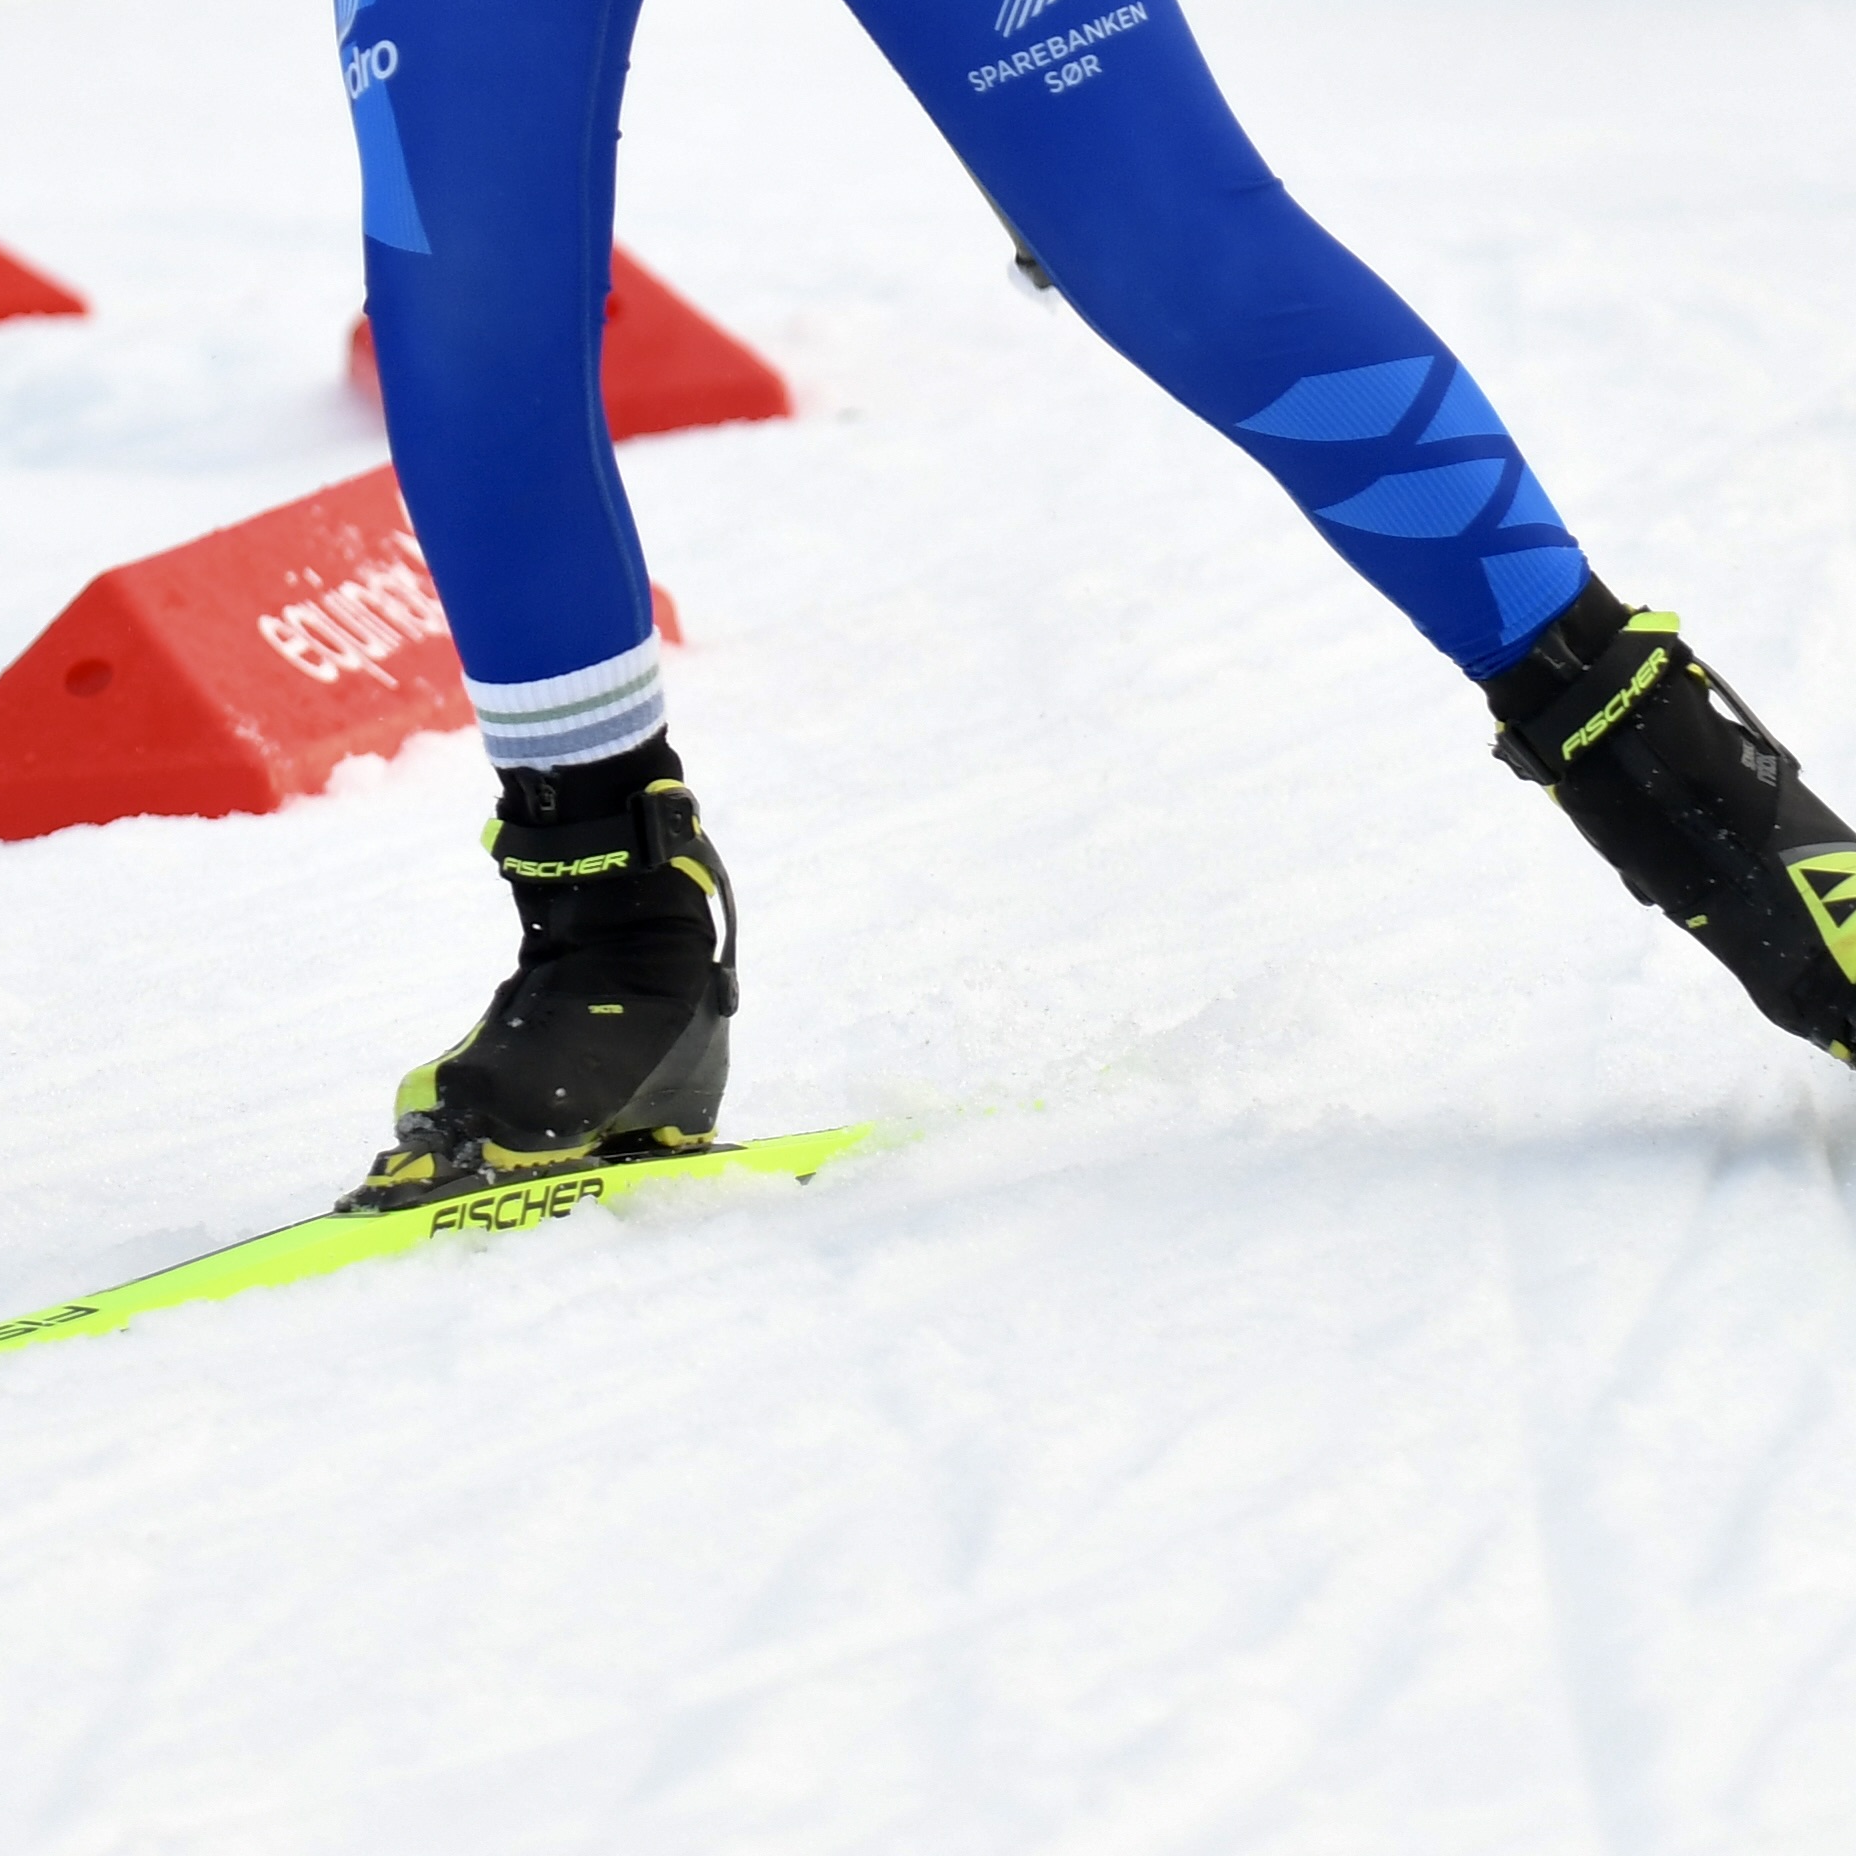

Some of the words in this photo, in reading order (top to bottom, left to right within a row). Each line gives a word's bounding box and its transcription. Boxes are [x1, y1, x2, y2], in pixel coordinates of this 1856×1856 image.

[967, 1, 1149, 93] SPAREBANKEN
[1044, 53, 1104, 93] SØR
[1561, 646, 1669, 762] FISCHER
[502, 850, 631, 879] FISCHER
[429, 1176, 605, 1239] FISCHER
